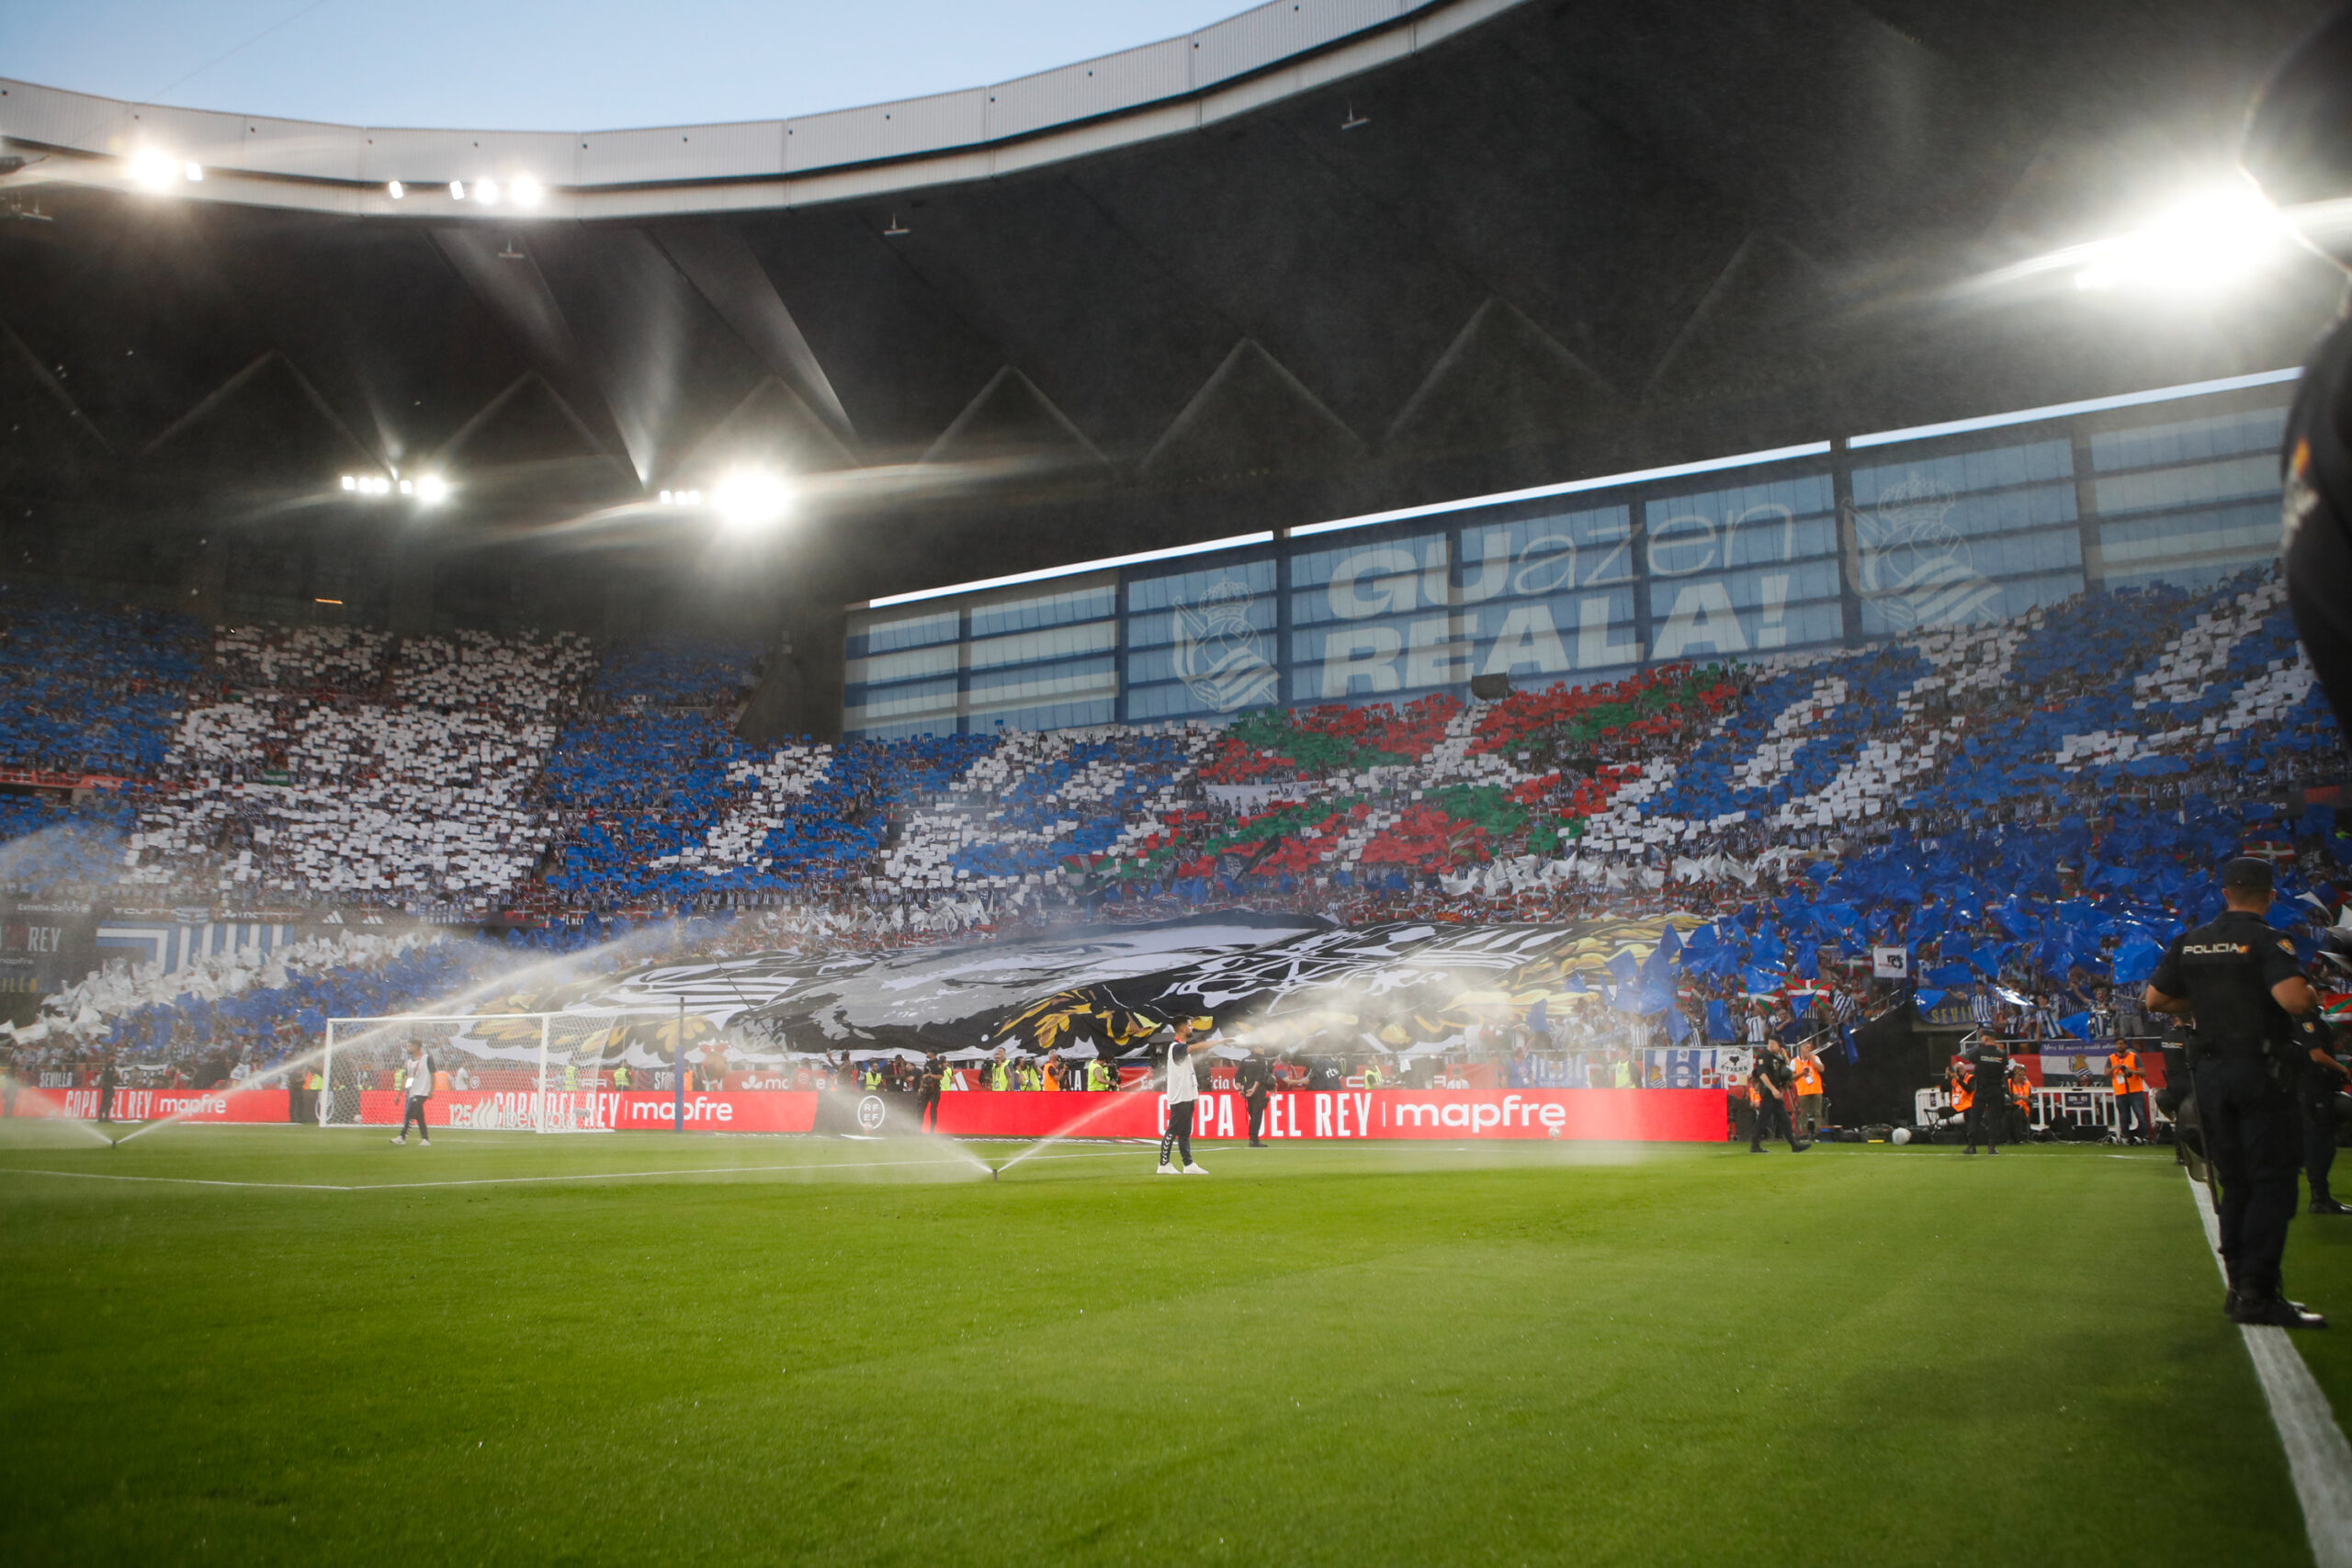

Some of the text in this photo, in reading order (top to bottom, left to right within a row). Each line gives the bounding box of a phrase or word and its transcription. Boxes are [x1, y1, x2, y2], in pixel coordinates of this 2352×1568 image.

[1329, 503, 1793, 620] GUazen
[1321, 574, 1790, 699] REALA!
[28, 926, 62, 952] REY
[2182, 942, 2240, 954] POLICIA
[1931, 1006, 1974, 1024] SEVIL
[40, 1072, 73, 1088] SEVILLA
[64, 1090, 98, 1118] COPA
[127, 1090, 153, 1119] REY
[160, 1093, 227, 1117] mapfre
[584, 1092, 620, 1128] REY
[1159, 1093, 1566, 1137] CPA EL REY mapfre
